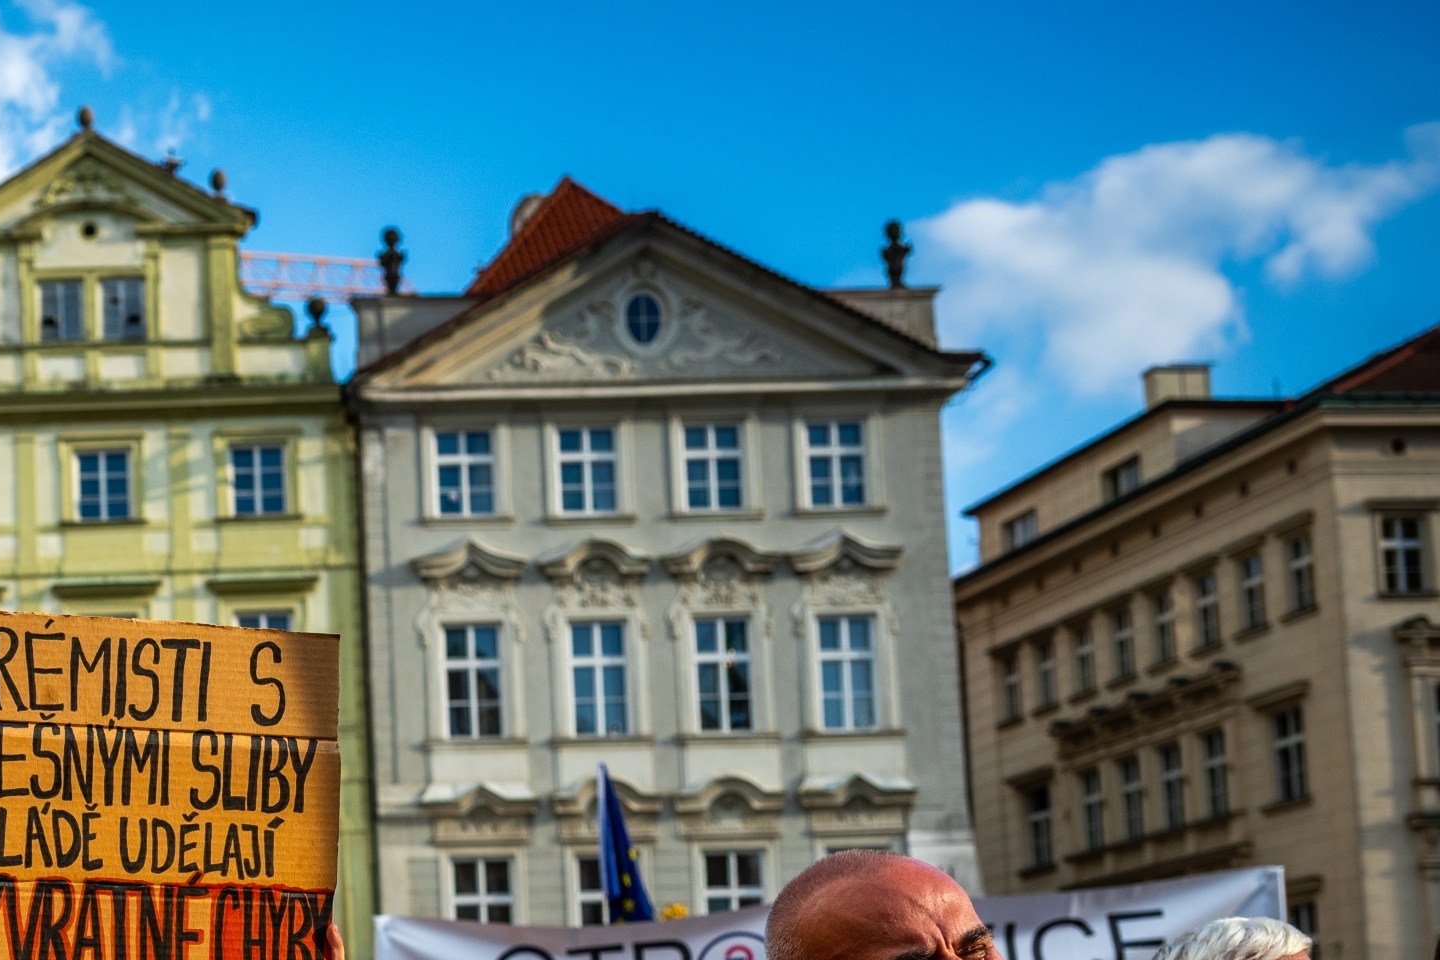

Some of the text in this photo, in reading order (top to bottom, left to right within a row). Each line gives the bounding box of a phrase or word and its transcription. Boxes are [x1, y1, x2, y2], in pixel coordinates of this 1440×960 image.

[249, 641, 287, 727] S
[189, 729, 319, 814] SLIBY
[119, 811, 286, 879] UDĚLAJÍ
